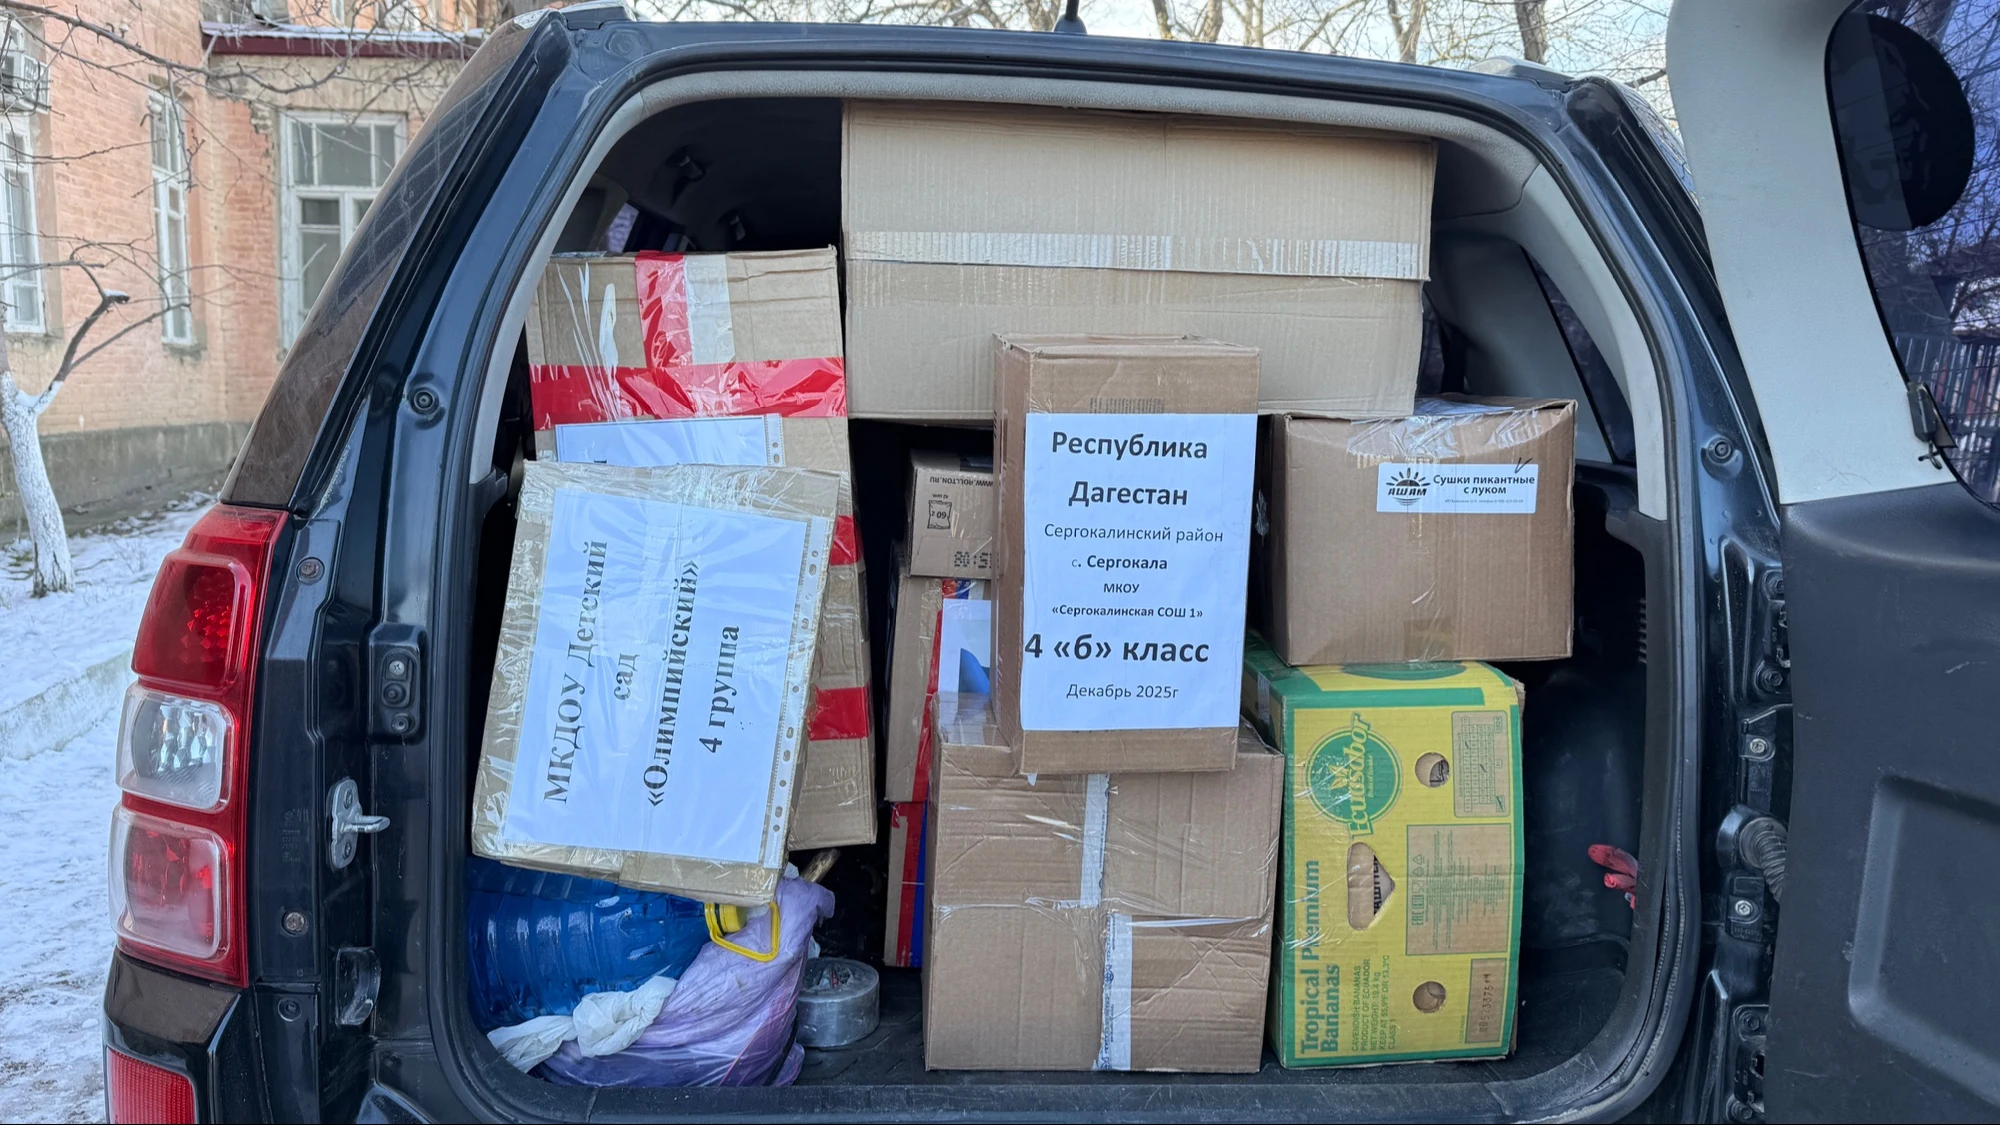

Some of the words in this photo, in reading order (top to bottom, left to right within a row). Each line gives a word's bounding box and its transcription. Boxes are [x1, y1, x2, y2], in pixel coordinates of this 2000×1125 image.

[1051, 431, 1208, 461] Республика
[1388, 487, 1428, 496] АШАМ
[1433, 474, 1471, 486] Сушки
[1473, 475, 1535, 485] пикантные
[1471, 487, 1507, 496] луком
[1068, 480, 1188, 507] Дагестан
[936, 511, 947, 519] 60
[1044, 523, 1171, 541] Сергокалинский
[1176, 527, 1223, 544] район
[1071, 559, 1082, 568] с.
[1086, 554, 1168, 571] Сергокала
[1103, 583, 1140, 594] МКОУ
[1052, 604, 1154, 617] «Сергокалинская
[1157, 607, 1186, 618] СОШ
[1189, 608, 1203, 618] 1»
[1024, 633, 1044, 659] 4
[1053, 633, 1112, 661] «б»
[1122, 642, 1210, 663] класс
[543, 672, 586, 804] МКДОУ
[567, 540, 608, 669] Детский
[613, 652, 640, 702] сад
[643, 560, 700, 807] «Олимпийский»
[708, 625, 740, 728] группа
[1066, 683, 1132, 700] Декабрь
[1136, 685, 1179, 699] 2025г
[698, 736, 723, 754] 4
[1341, 714, 1372, 837] Ecuasabor
[1301, 861, 1319, 961] Premium
[1352, 965, 1361, 1005] BANANAS
[1362, 959, 1371, 999] ECUADOR
[1372, 972, 1381, 982] kg
[1382, 980, 1389, 993] OR
[1299, 968, 1324, 1054] Tropical
[1320, 964, 1340, 1053] Bananas
[1362, 1001, 1370, 1012] OF
[1371, 1002, 1379, 1034] WEIGHT:
[1351, 1006, 1360, 1052] CAVENDISH
[1361, 1014, 1370, 1051] PRODUCT
[1380, 1019, 1387, 1029] AT
[1388, 1024, 1397, 1049] CLASS
[1379, 1029, 1387, 1050] KEEP
